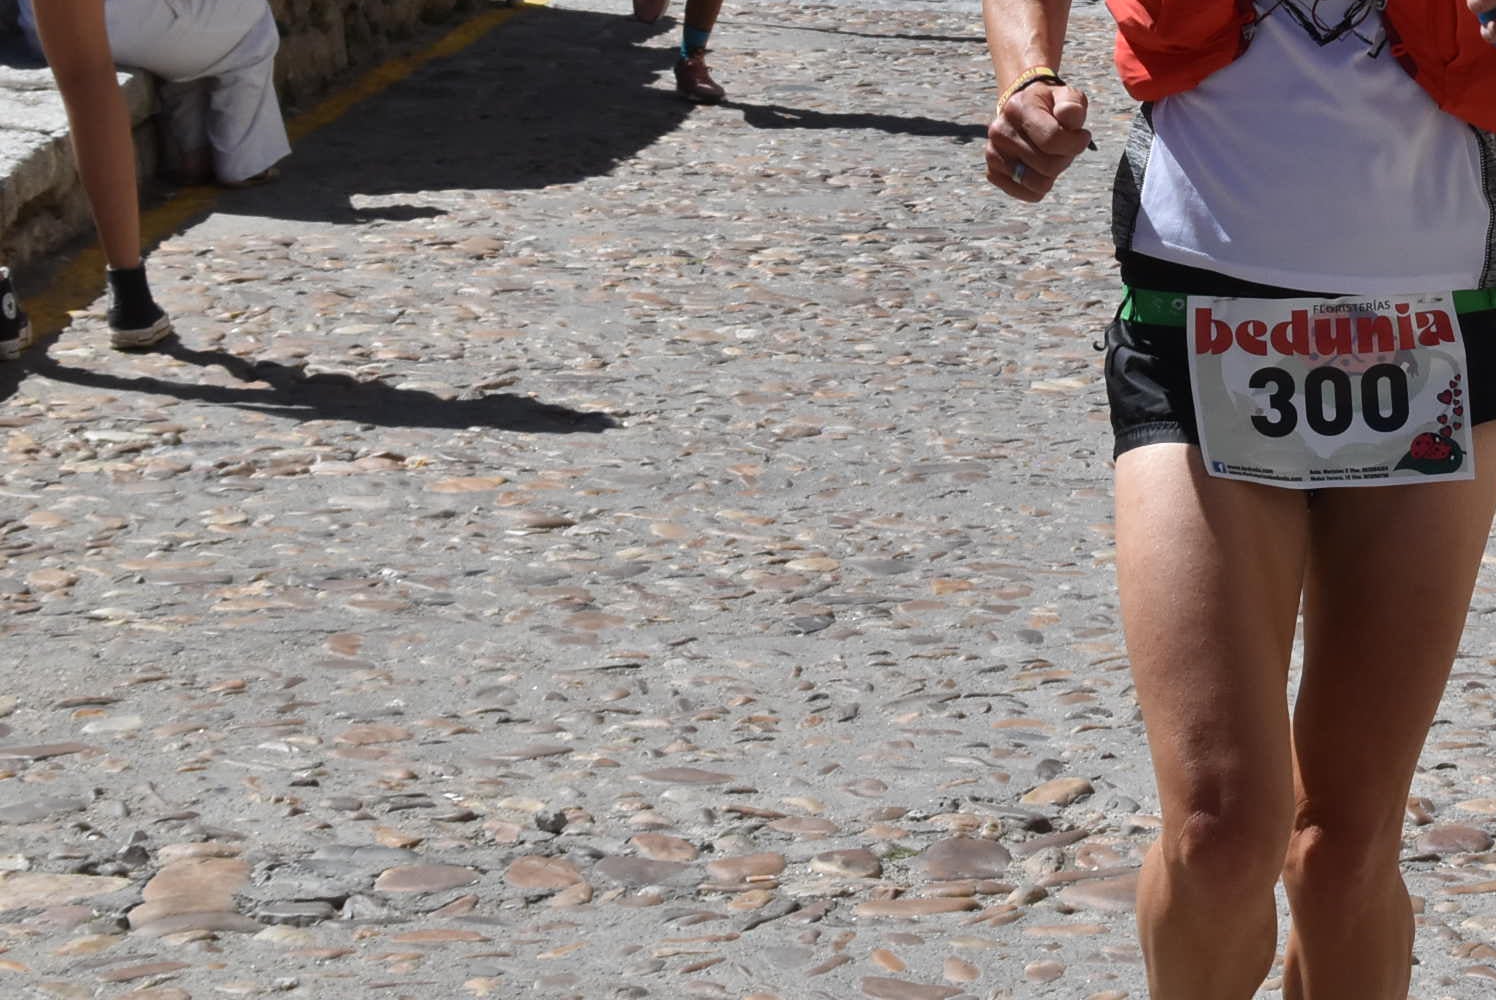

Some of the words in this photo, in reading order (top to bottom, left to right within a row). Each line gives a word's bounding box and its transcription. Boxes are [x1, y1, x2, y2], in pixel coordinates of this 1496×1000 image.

[1195, 302, 1456, 357] bedunia
[1312, 300, 1391, 314] FLORISTERÍAS
[1249, 363, 1410, 438] 300
